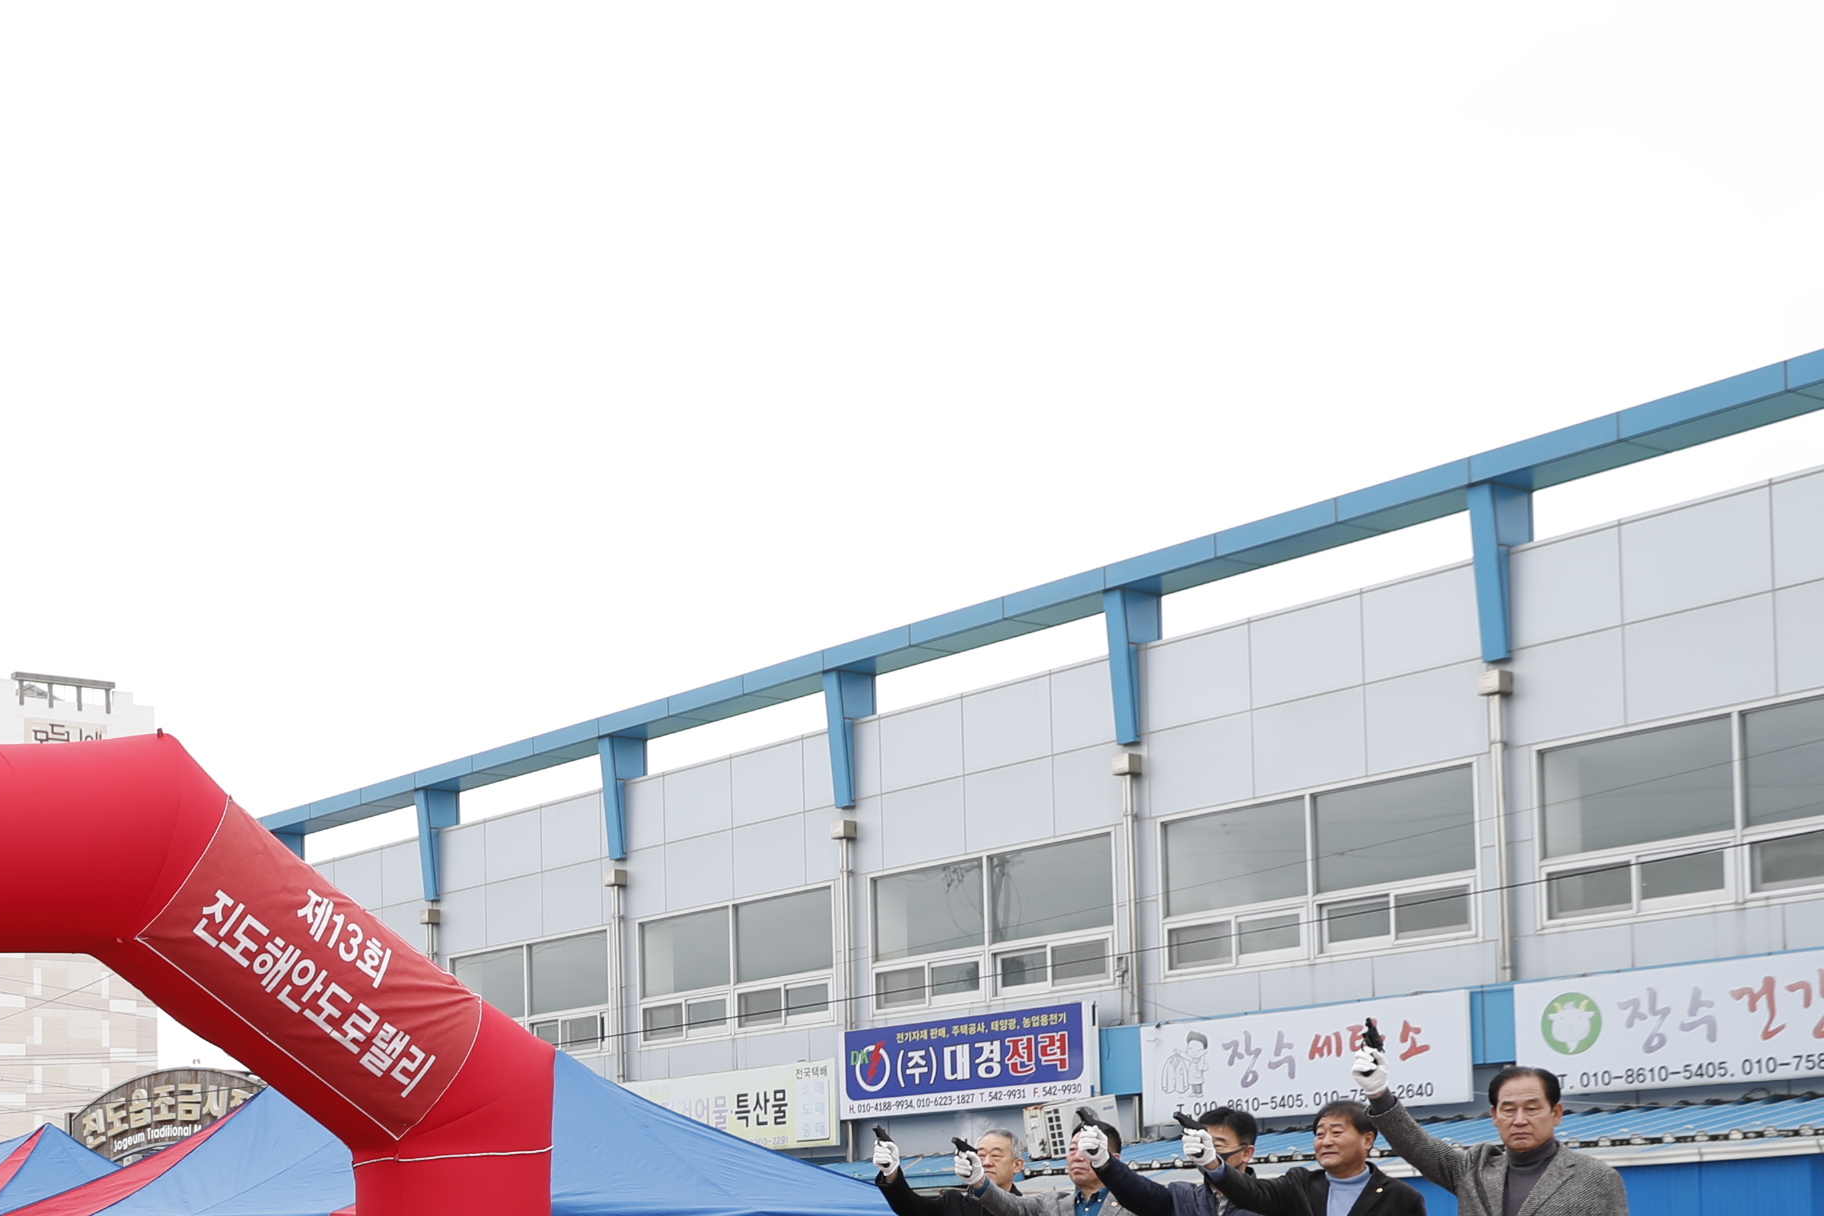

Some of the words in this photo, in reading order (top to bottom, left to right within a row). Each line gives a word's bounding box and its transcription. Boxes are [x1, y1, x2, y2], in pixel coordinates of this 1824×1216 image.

[297, 888, 392, 989] 제13회
[192, 888, 437, 1098] 진도해안도로랠리
[1617, 986, 1718, 1054] 장수
[895, 1029, 928, 1043] 전기자재
[1022, 1012, 1067, 1028] 농업용전기
[795, 1065, 828, 1079] 전국택배
[1221, 1030, 1296, 1089] 장수
[113, 1132, 146, 1153] Jogeum
[147, 1123, 192, 1141] Traditional
